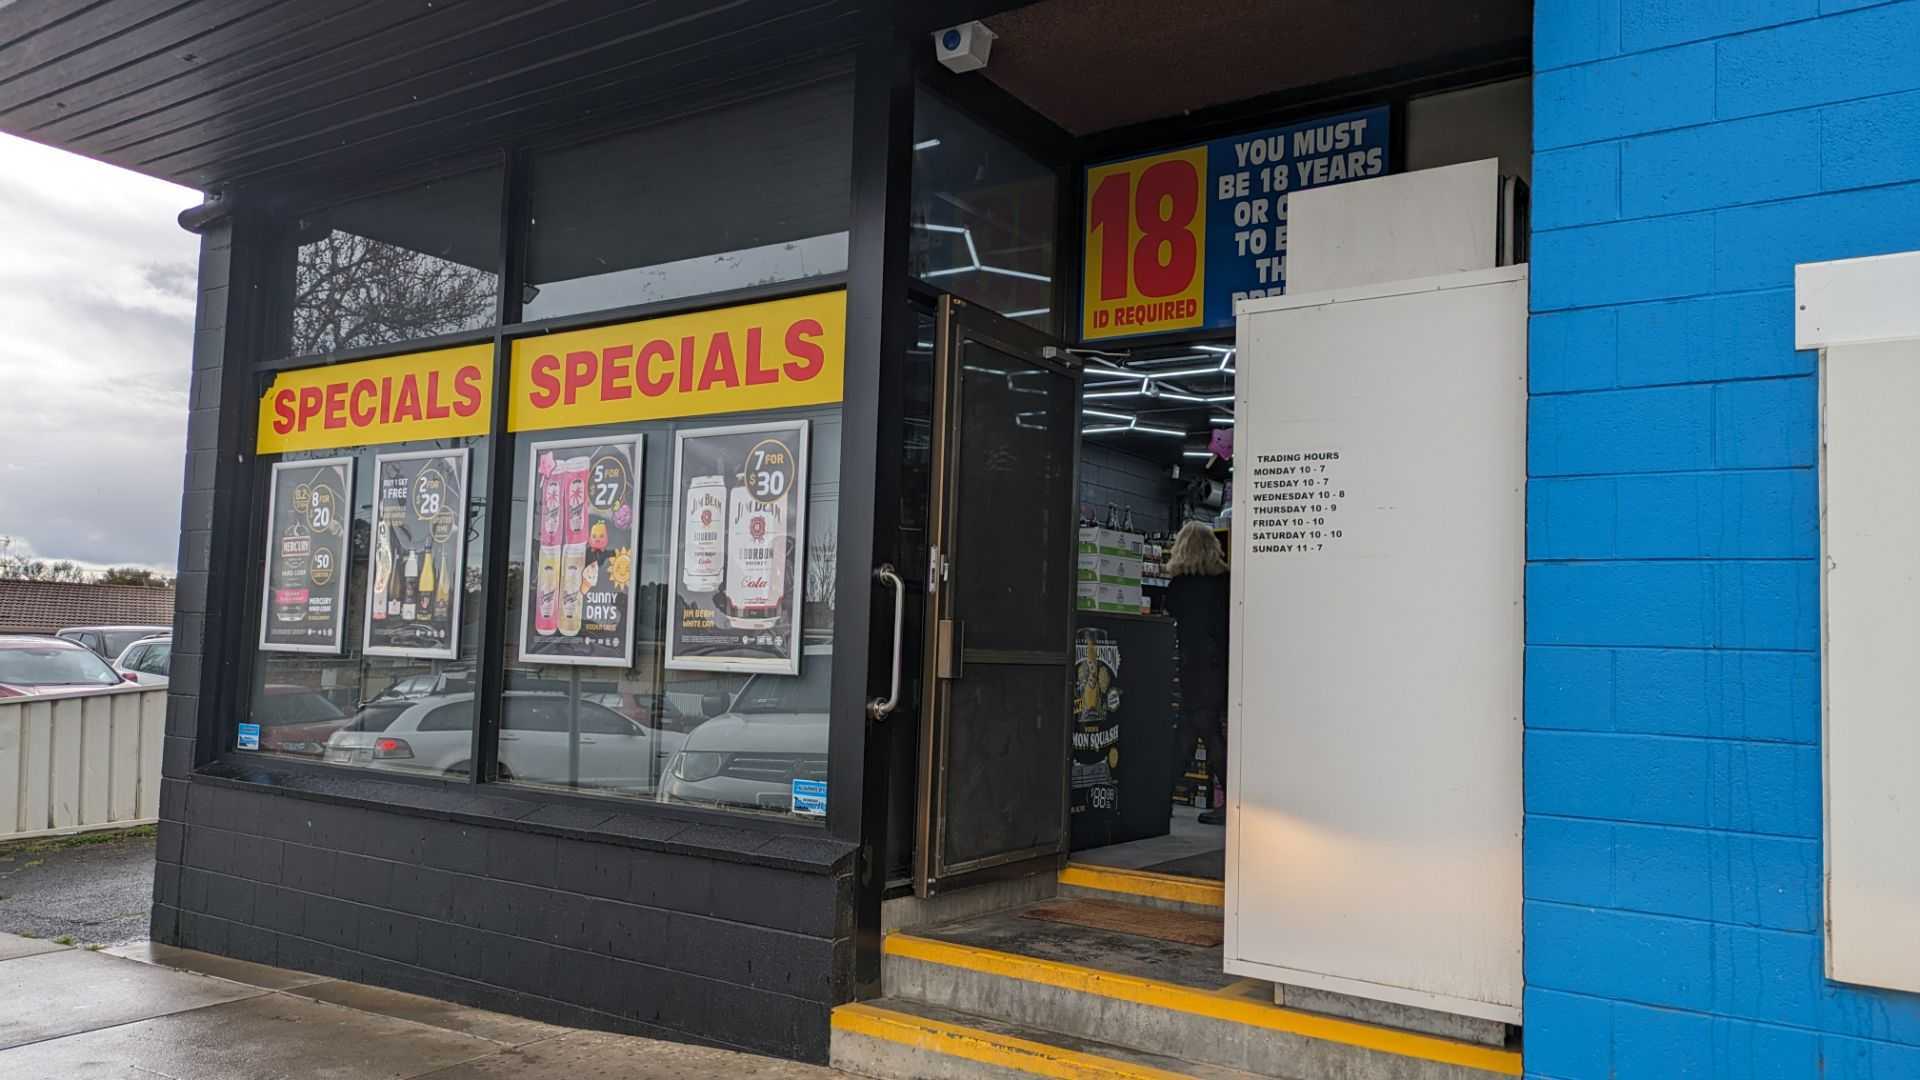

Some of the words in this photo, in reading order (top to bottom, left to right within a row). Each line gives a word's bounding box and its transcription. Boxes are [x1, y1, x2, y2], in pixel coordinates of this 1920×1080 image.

[1235, 135, 1285, 168] YOU
[1293, 119, 1368, 157] MUST
[1218, 171, 1250, 201] BE
[1261, 164, 1289, 194] 18
[1297, 147, 1382, 187] YEARS
[1234, 198, 1269, 228] OR
[1090, 158, 1199, 302] 18
[1234, 228, 1268, 256] TO
[1093, 308, 1109, 329] ID
[1115, 298, 1197, 327] REQUIRED
[529, 319, 825, 408] SPECIALS
[272, 365, 482, 435] SPECIALS
[755, 451, 764, 470] 7
[765, 454, 785, 465] FOR
[1257, 453, 1301, 463] TRADING
[1304, 452, 1340, 461] HOURS
[594, 465, 604, 482] 5
[1254, 467, 1296, 476] MONDAY
[1299, 466, 1311, 474] 10
[1320, 465, 1326, 473] 7
[419, 477, 427, 492] 2
[749, 472, 785, 496] $30
[1254, 480, 1299, 489] TUESDAY
[1302, 479, 1314, 487] 10
[1323, 478, 1329, 486] 7
[311, 492, 319, 506] 8
[388, 488, 408, 498] FREE
[1253, 492, 1315, 502] WEDNESDAY
[1318, 491, 1330, 499] 10
[1339, 490, 1345, 498] 8
[1253, 505, 1307, 514] THURSDAY
[1310, 504, 1322, 512] 10
[1330, 504, 1337, 512] 9
[1253, 519, 1289, 528] FRIDAY
[1292, 518, 1303, 526] 10
[1313, 517, 1324, 525] 10
[1253, 531, 1306, 540] SATURDAY
[1309, 530, 1321, 538] 10
[1330, 530, 1342, 538] 10
[1252, 544, 1293, 553] SUNDAY
[1297, 544, 1308, 552] 11
[586, 605, 617, 620] DAYS
[1072, 732, 1089, 747] MON
